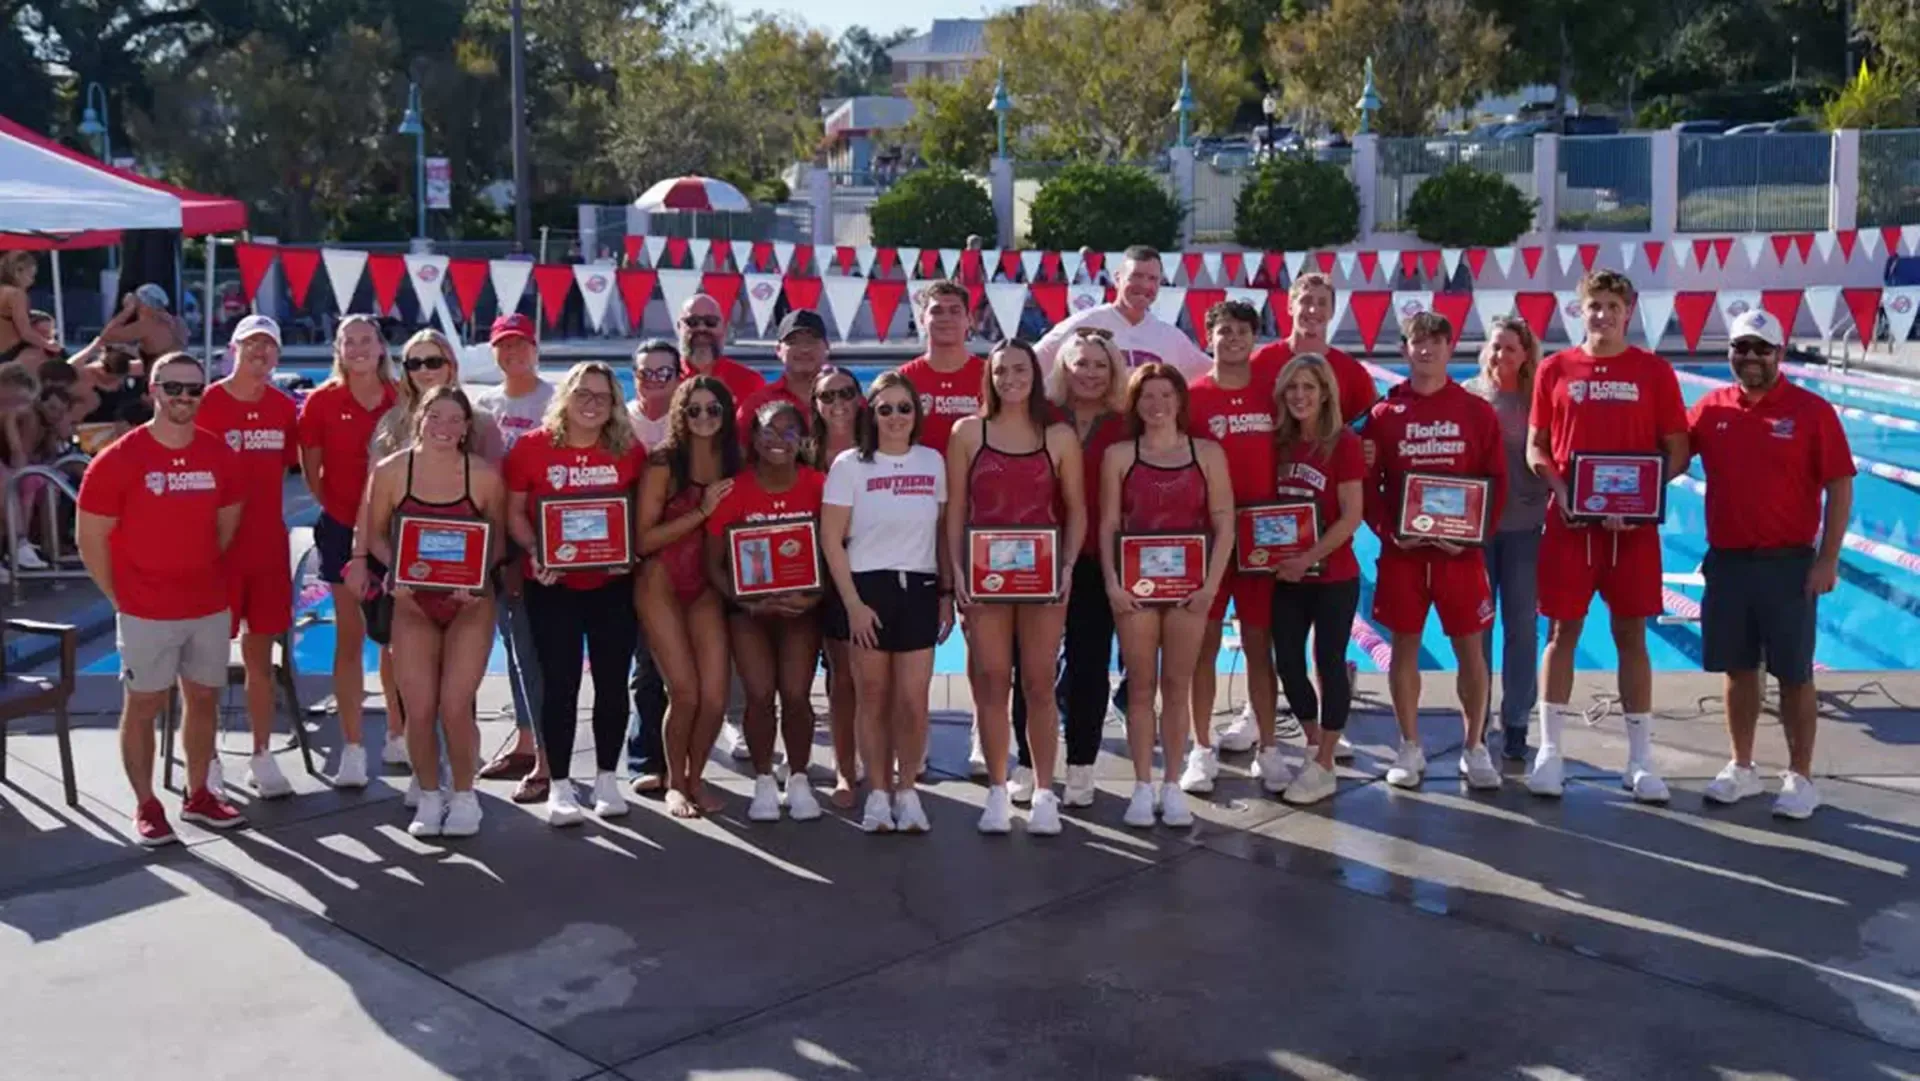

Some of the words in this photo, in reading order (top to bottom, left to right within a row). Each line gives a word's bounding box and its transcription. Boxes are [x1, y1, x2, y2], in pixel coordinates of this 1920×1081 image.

[1406, 420, 1460, 438] Florida
[1398, 439, 1466, 456] Southern
[866, 474, 936, 492] SOUTHERN
